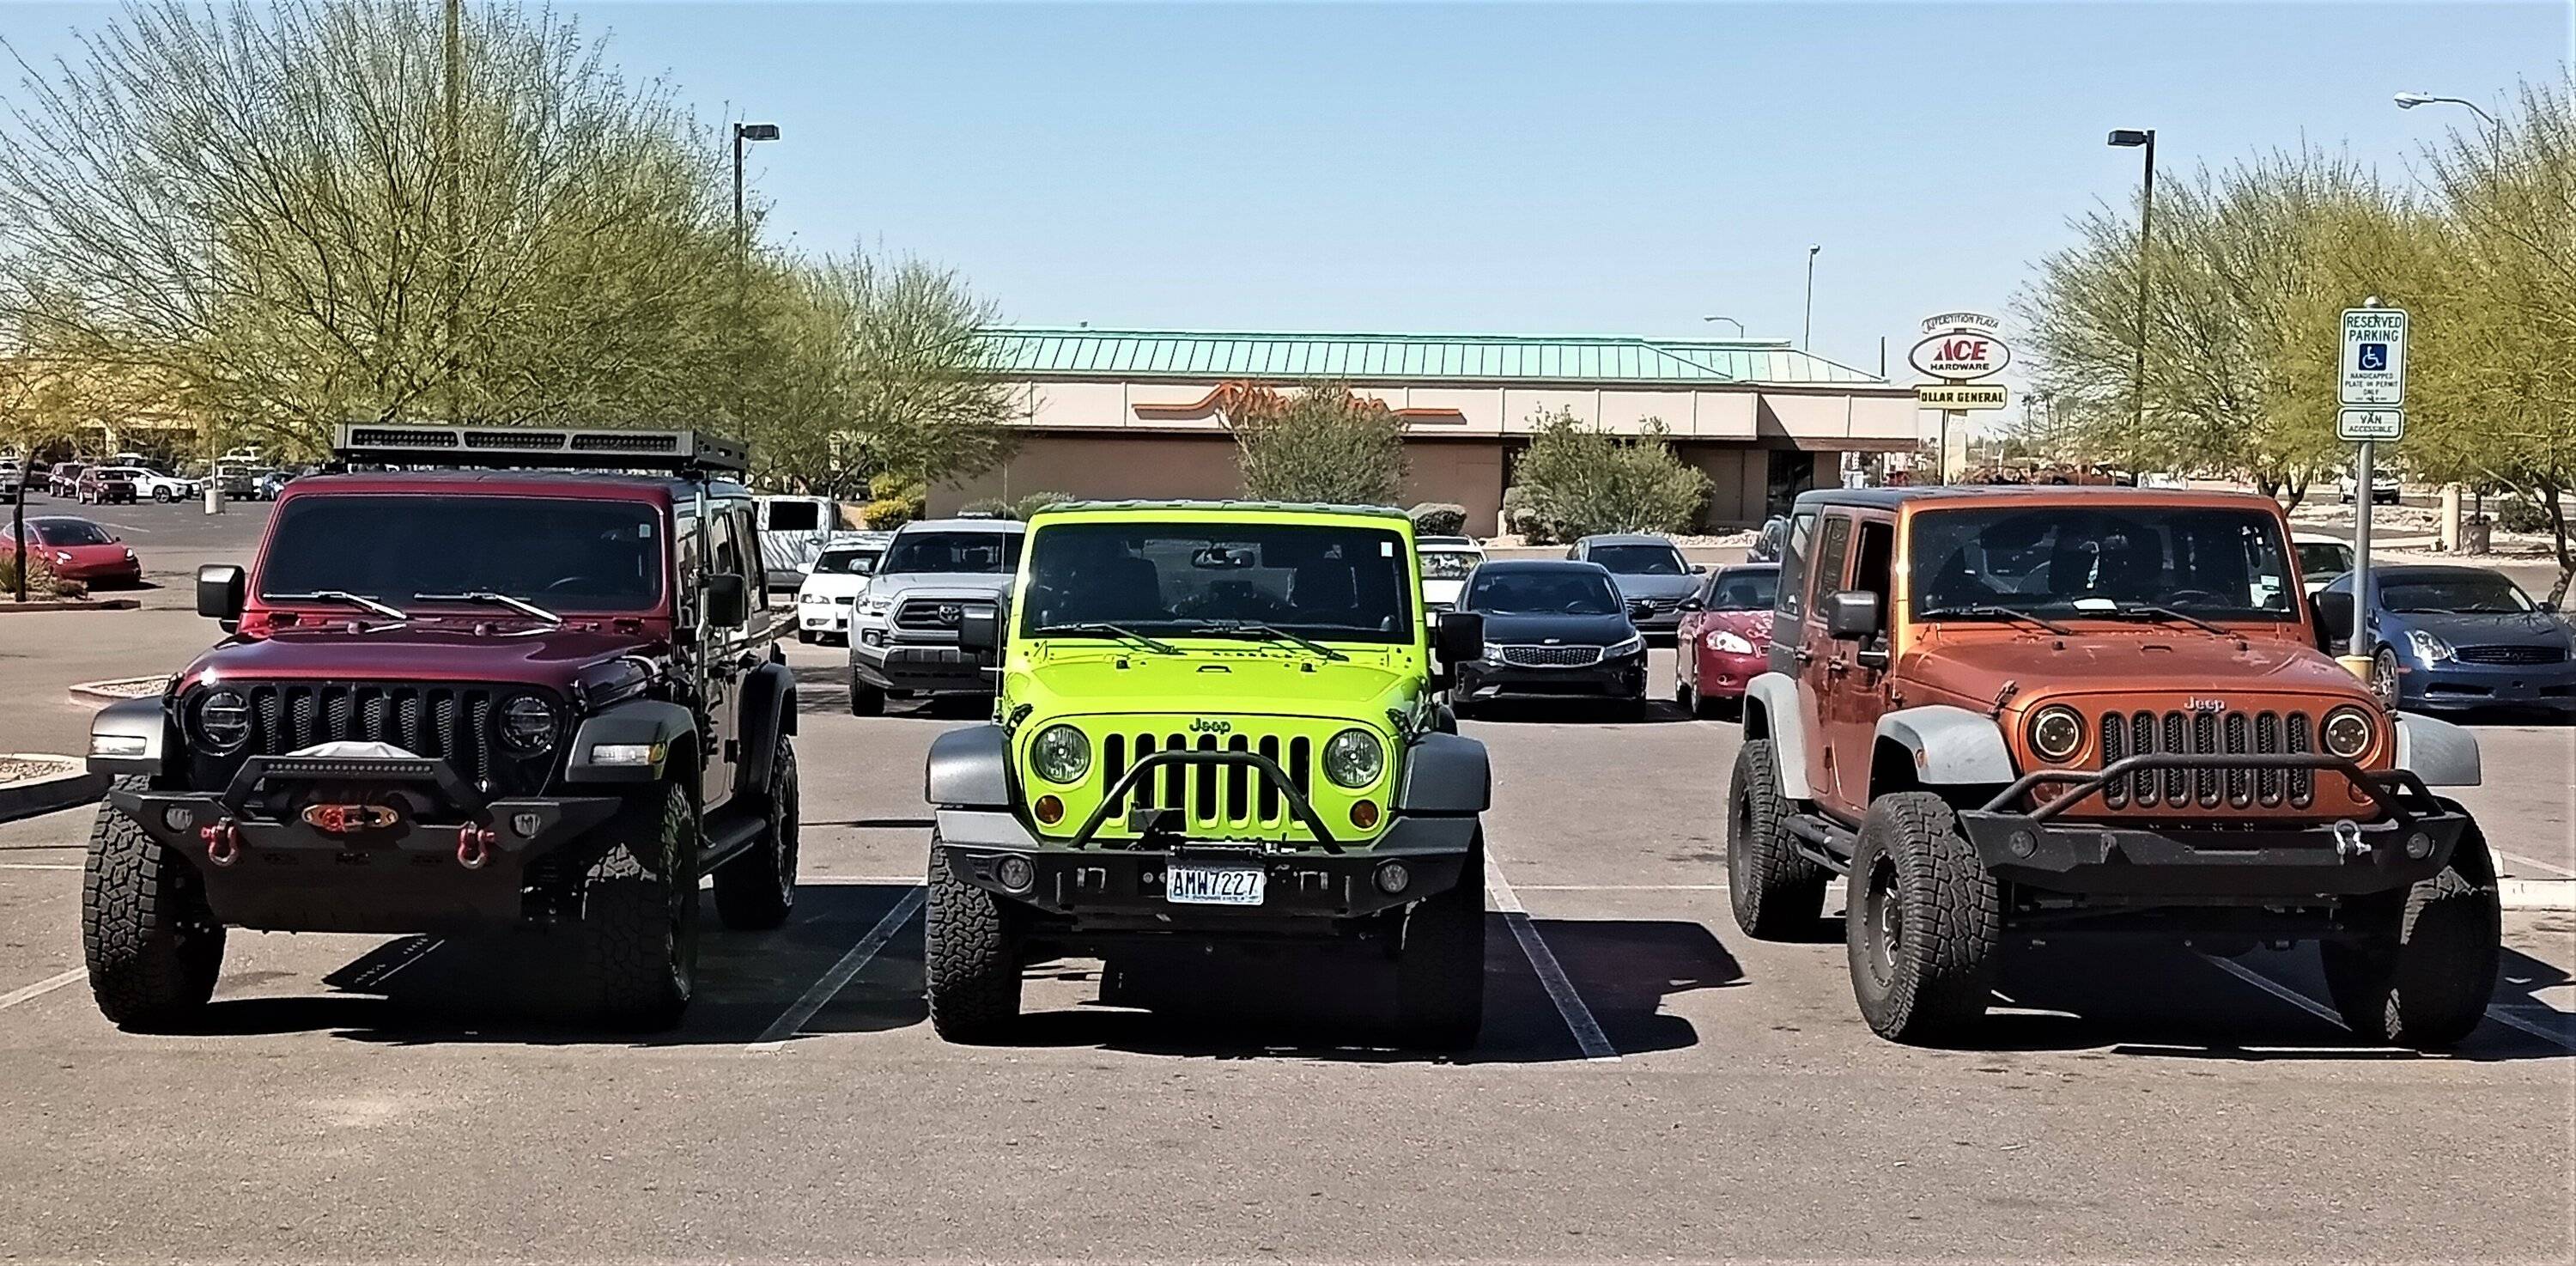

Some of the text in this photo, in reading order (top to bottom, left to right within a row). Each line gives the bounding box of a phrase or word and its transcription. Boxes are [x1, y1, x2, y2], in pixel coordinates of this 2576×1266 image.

[1975, 315, 1999, 328] PLAZA
[2347, 315, 2402, 328] RESERVED
[2348, 330, 2399, 342] PARKING
[1934, 338, 1989, 361] ACE
[1921, 392, 2004, 403] OLLAR GENERAL
[2360, 415, 2382, 424] VAN
[2184, 696, 2226, 713] Jeep
[1188, 717, 1231, 735] Jeep
[1173, 871, 1259, 896] AMW7227
